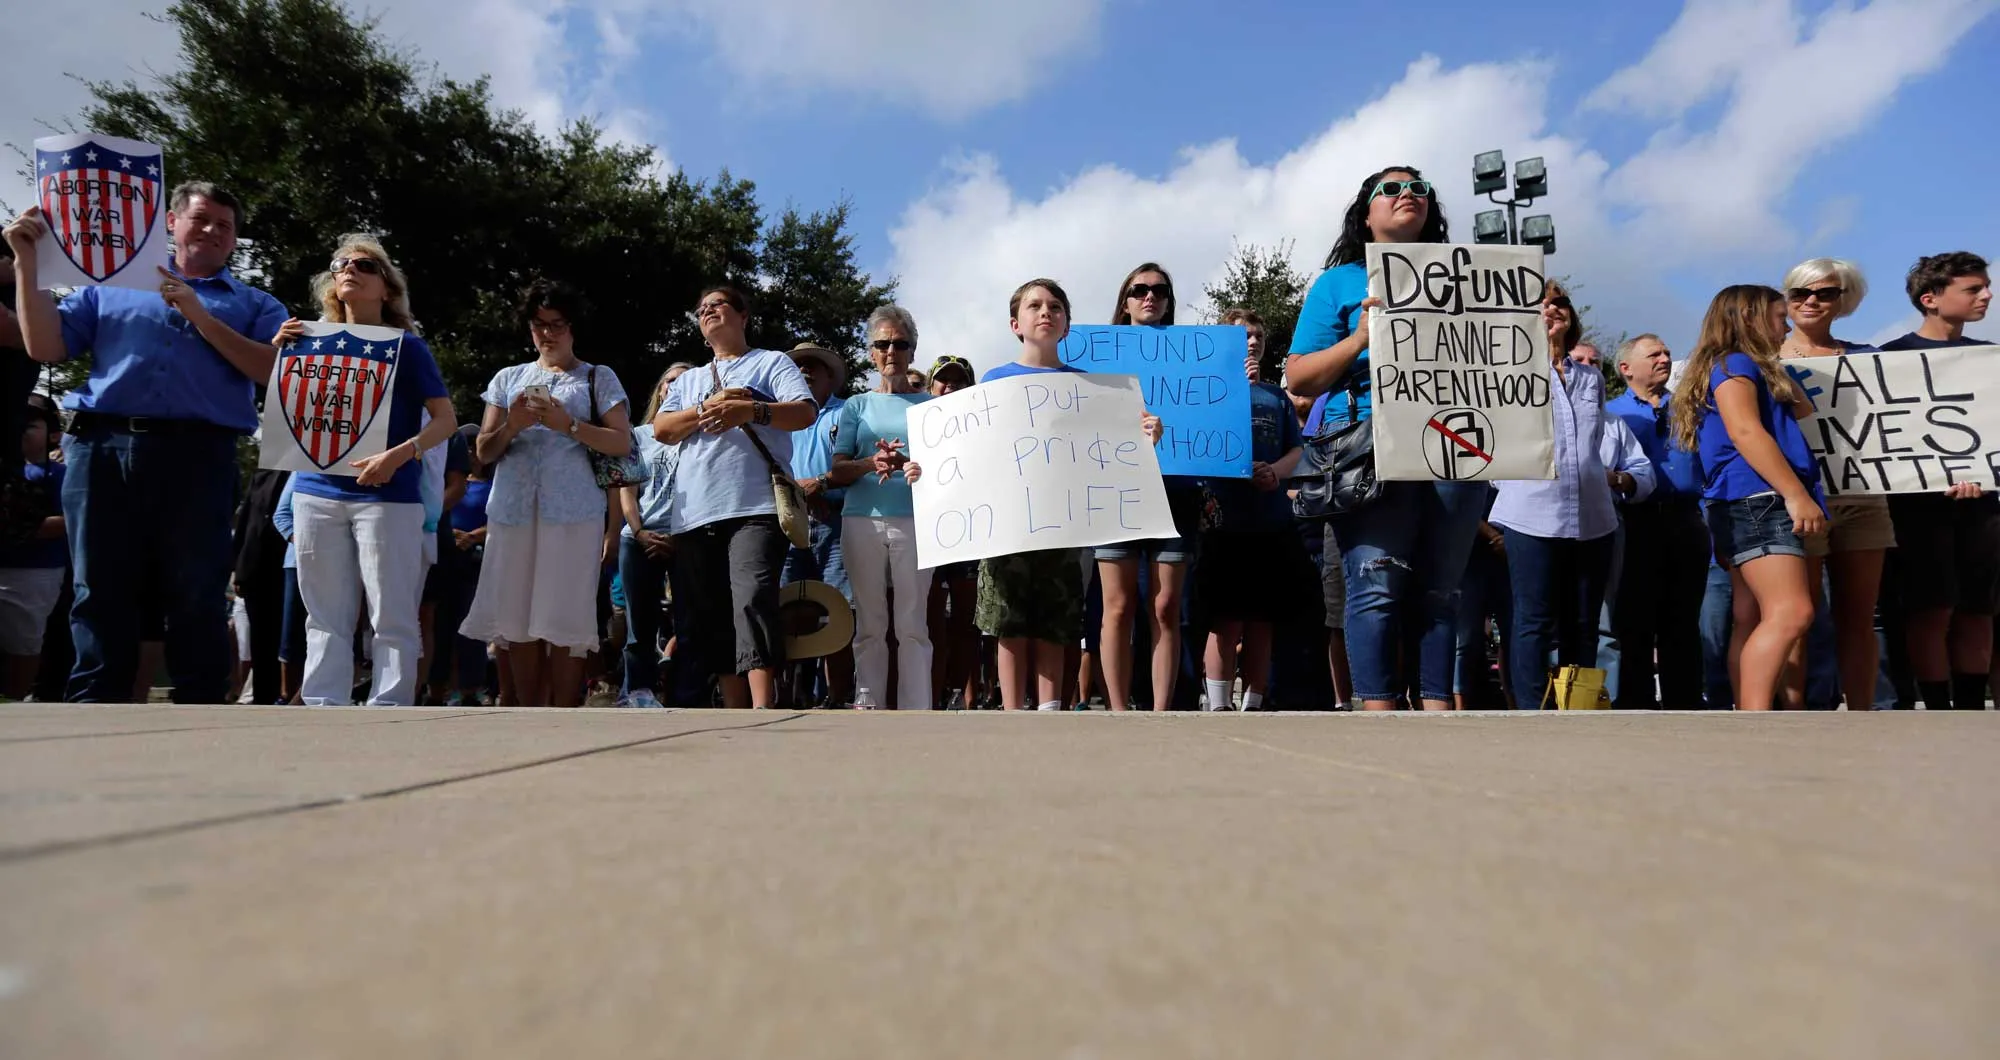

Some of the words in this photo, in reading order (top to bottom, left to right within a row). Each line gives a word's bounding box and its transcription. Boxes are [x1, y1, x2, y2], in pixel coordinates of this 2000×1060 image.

[45, 175, 149, 203] ABORTION
[72, 207, 120, 224] WAR
[62, 232, 135, 250] WOMEN
[1064, 330, 1215, 363] DEFUND
[1390, 317, 1533, 366] PLANNED
[284, 357, 381, 385] ABORTION
[310, 391, 352, 409] WAR
[1376, 364, 1550, 408] PARENTHOOD
[292, 415, 361, 435] WOMEN
[936, 456, 963, 486] a
[935, 503, 993, 549] on
[1026, 485, 1142, 534] LIFE
